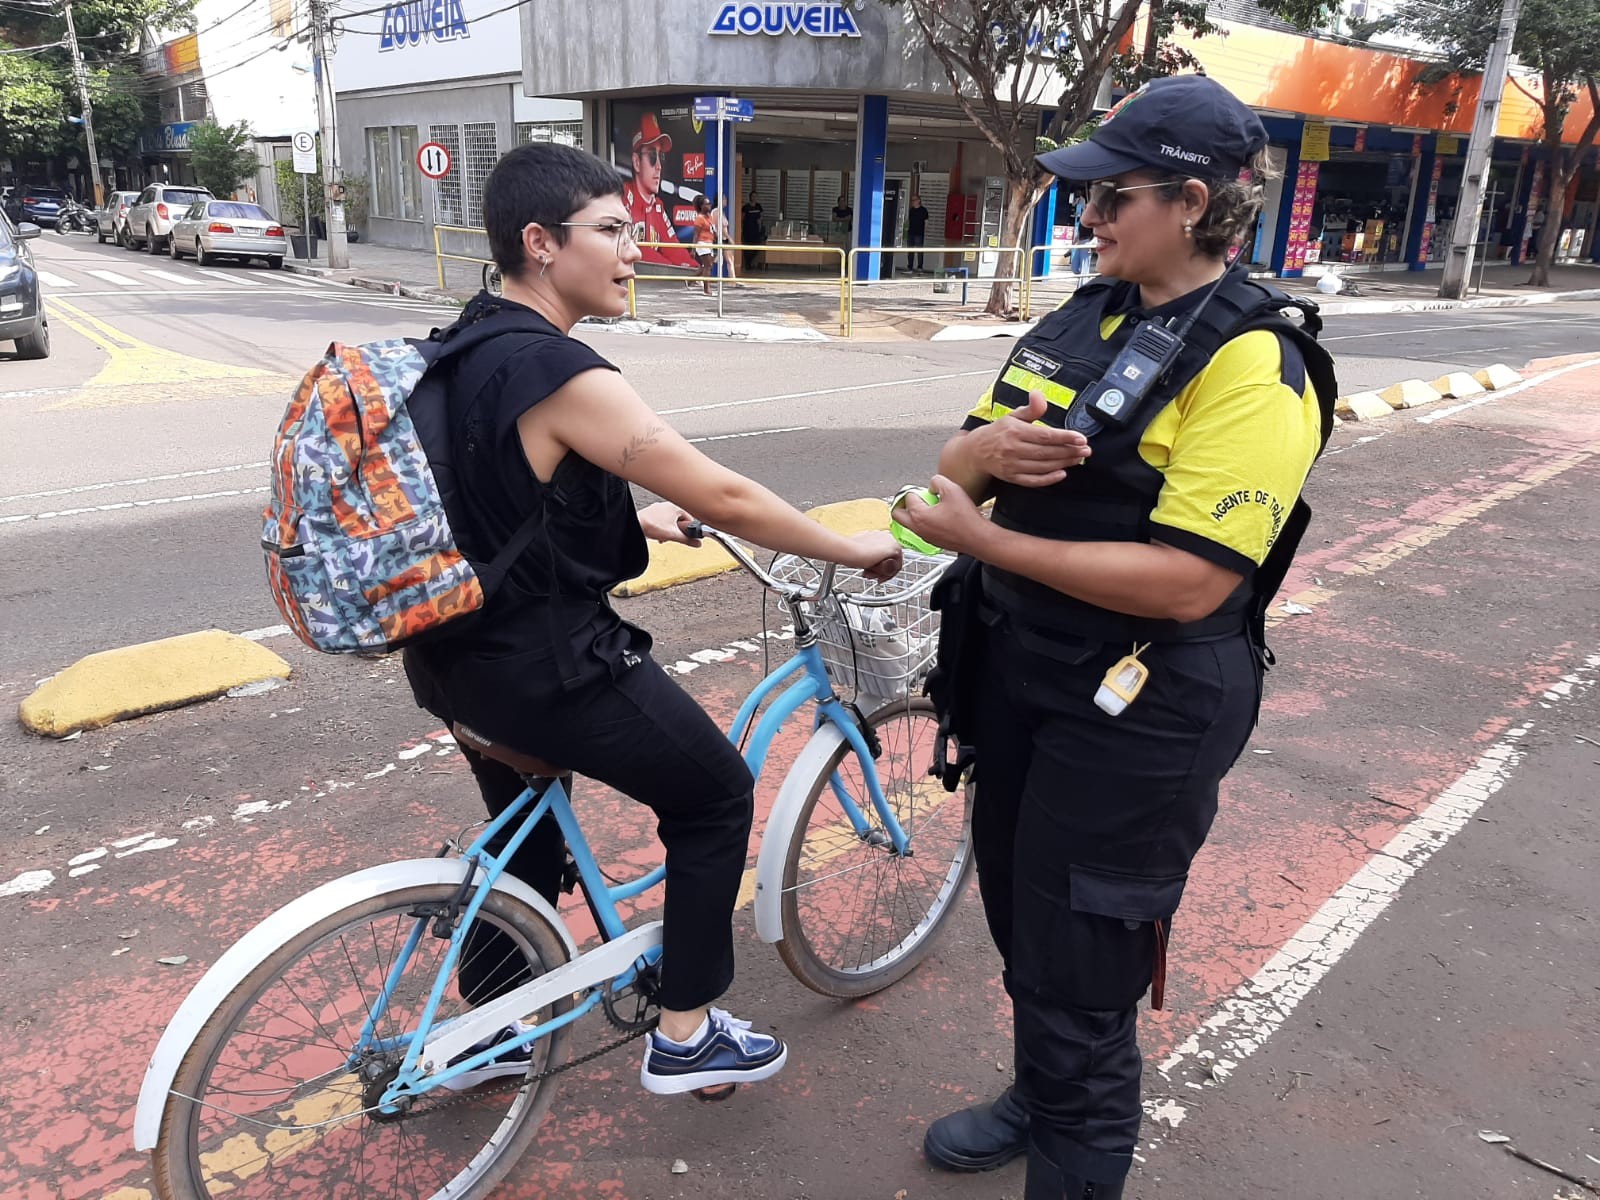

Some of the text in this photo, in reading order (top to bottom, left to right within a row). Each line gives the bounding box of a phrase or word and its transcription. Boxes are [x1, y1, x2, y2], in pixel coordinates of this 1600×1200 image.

[380, 0, 469, 51] GOUVEIA
[709, 3, 860, 36] GOUVEIA
[300, 136, 307, 148] E
[1160, 144, 1210, 165] TRÂNSITO
[1211, 490, 1250, 521] AGENTE
[1255, 490, 1269, 505] DE
